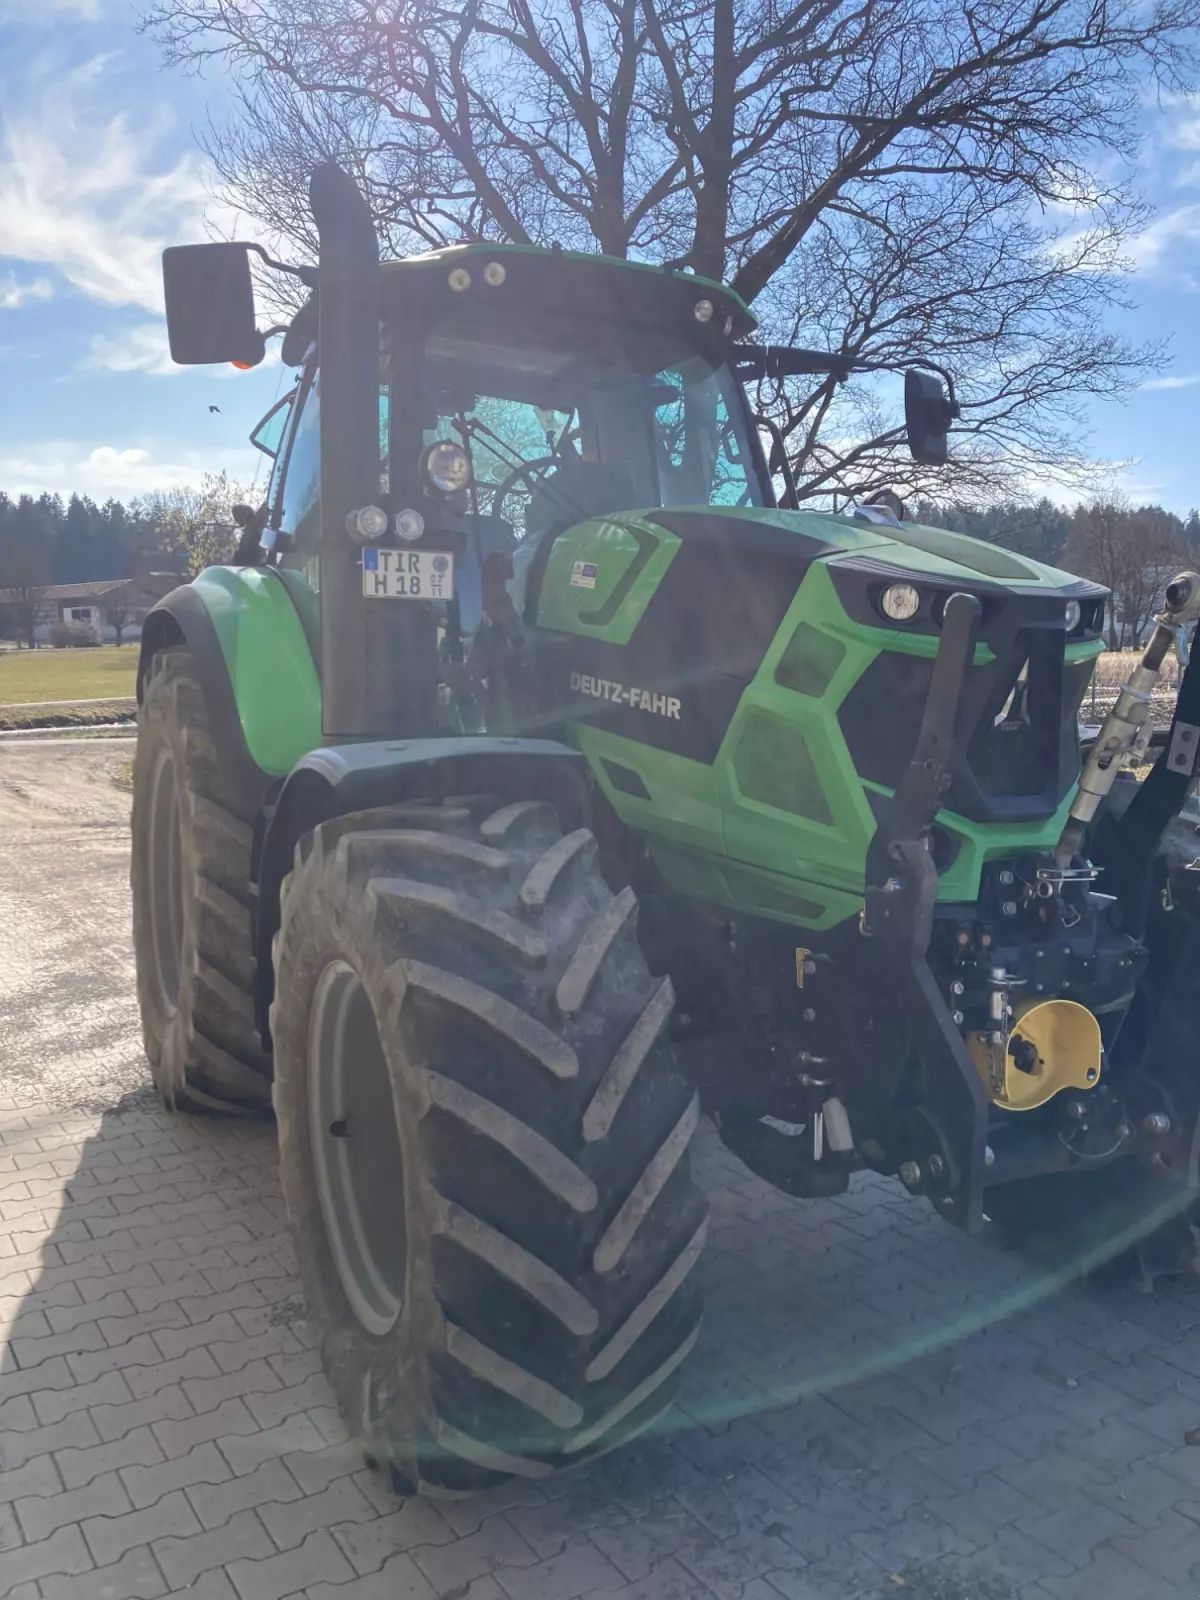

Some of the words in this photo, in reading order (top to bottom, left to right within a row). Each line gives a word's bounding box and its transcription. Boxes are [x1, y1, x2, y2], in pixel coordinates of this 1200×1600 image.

[380, 552, 420, 574] TIR
[374, 573, 388, 594] H
[396, 576, 421, 595] 18
[570, 671, 681, 720] DEUTZ-FAHR
